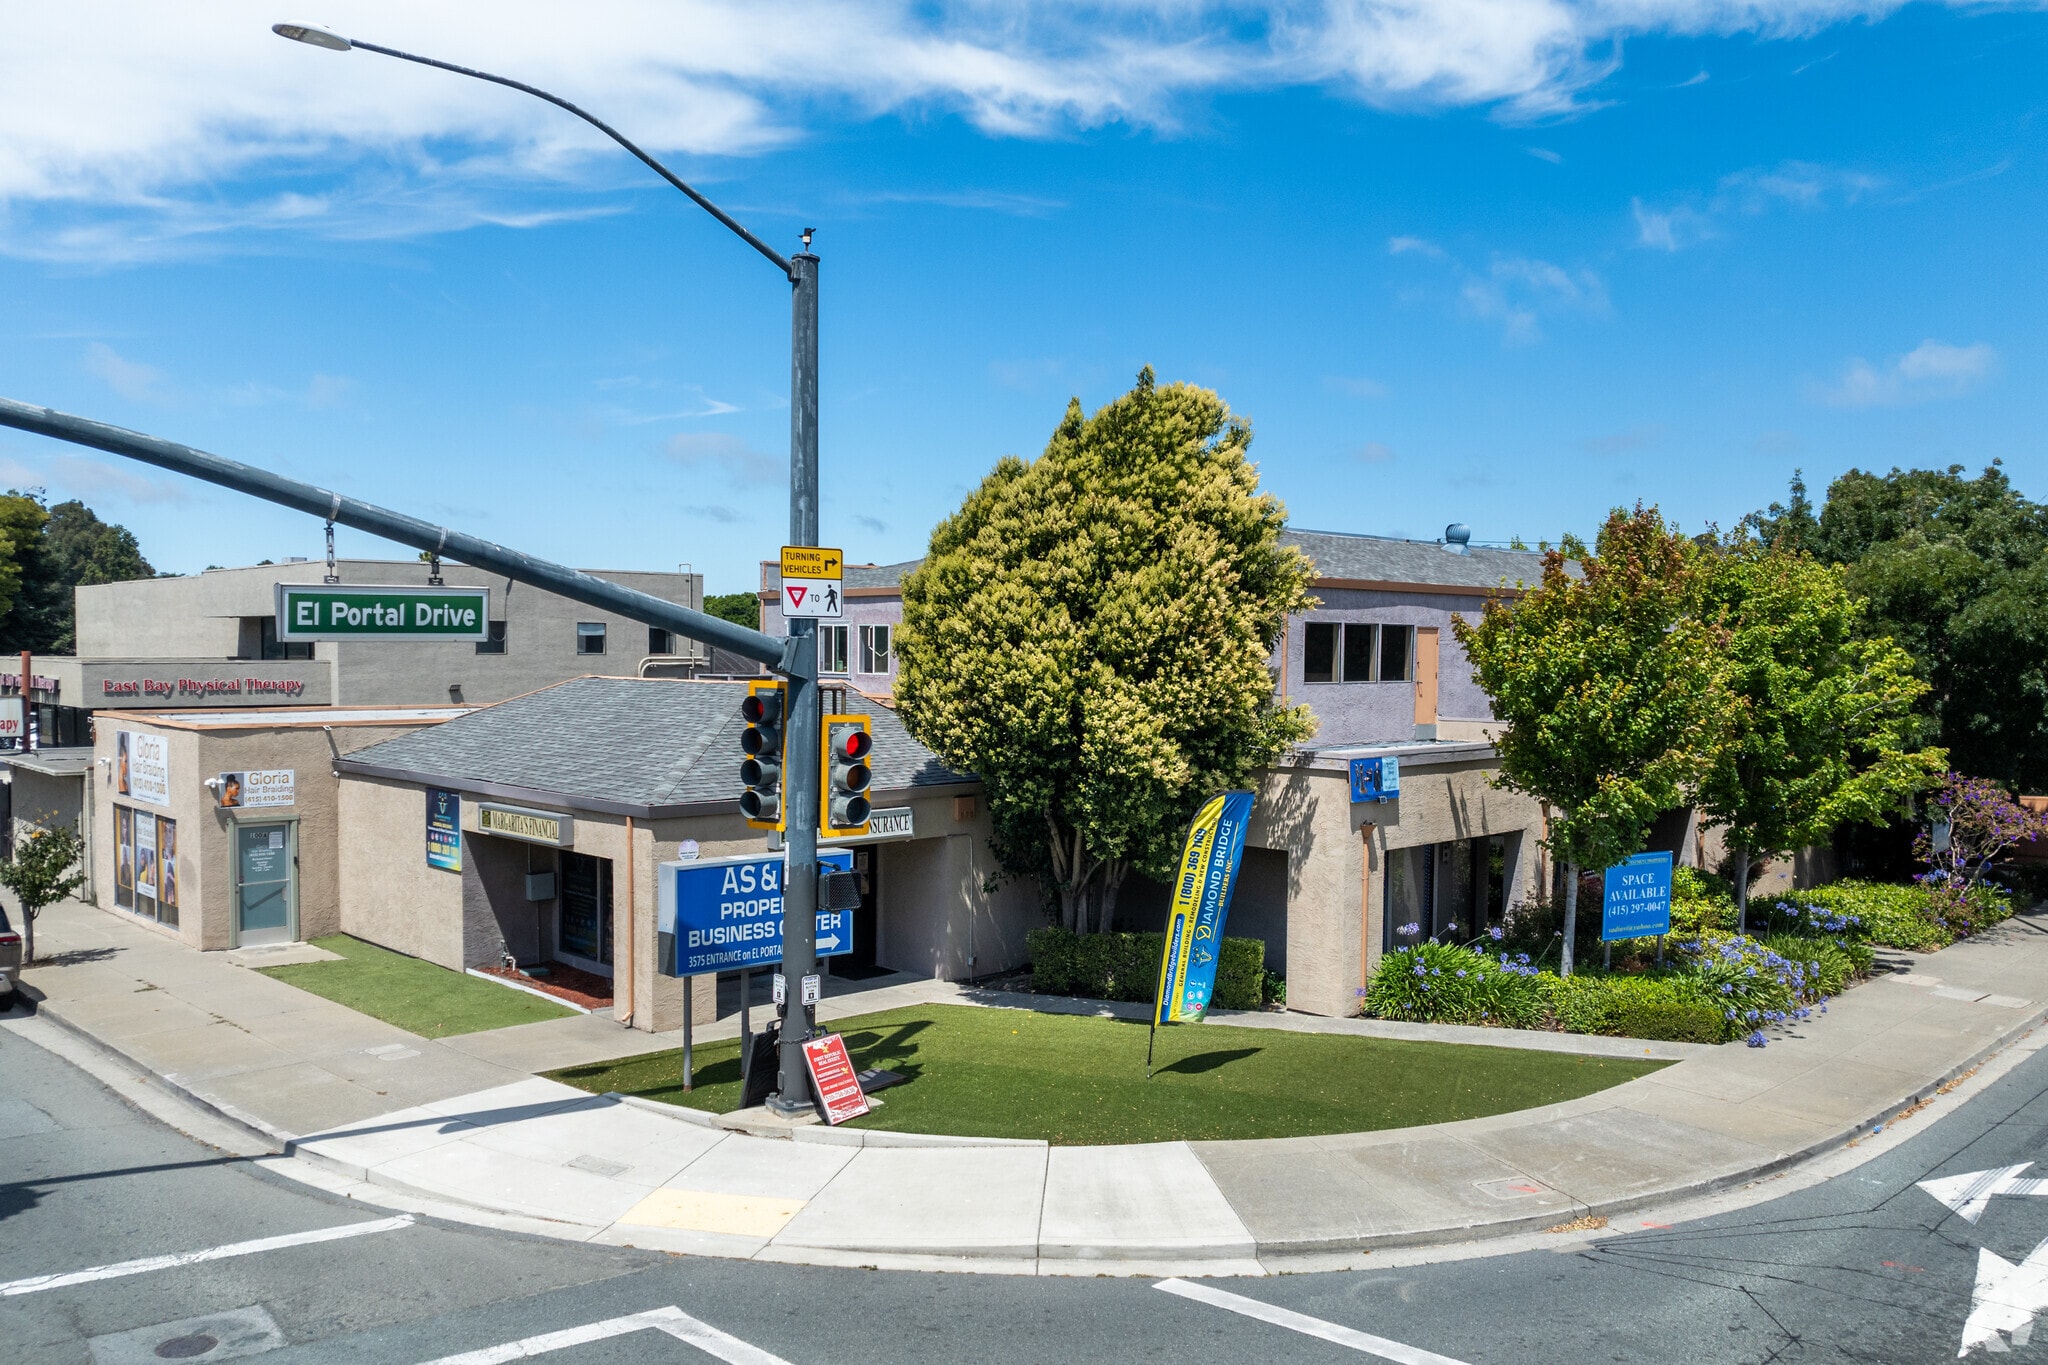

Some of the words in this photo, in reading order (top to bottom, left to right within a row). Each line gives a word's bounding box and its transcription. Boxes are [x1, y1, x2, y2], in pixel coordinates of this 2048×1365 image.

[785, 552, 820, 561] TURNING
[784, 565, 821, 574] VEHICLES
[810, 594, 820, 602] TO
[296, 601, 319, 625] El
[332, 602, 405, 626] Portal
[415, 603, 475, 626] Drive
[103, 679, 138, 692] East
[143, 679, 172, 694] Bay
[178, 678, 240, 694] Physical
[245, 678, 303, 693] Therapy
[137, 735, 160, 761] Gloria
[244, 786, 260, 794] Hair
[263, 784, 294, 793] Braiding
[249, 772, 289, 785] Gloria
[492, 811, 528, 835] MARGARITA'S
[529, 818, 560, 840] FINANCIAL
[1214, 819, 1233, 867] BRIDGE
[1187, 850, 1200, 871] 369
[1180, 872, 1196, 898] (800)
[1622, 873, 1655, 886] SPACE
[1609, 886, 1666, 902] AVAILABLE
[721, 897, 784, 920] PROPE
[1608, 905, 1629, 918] (415)
[1631, 901, 1666, 914] 297-0047
[1183, 929, 1192, 958] BUILDING
[1188, 884, 1202, 924] REMODELING
[688, 921, 775, 948] BUSINESS
[688, 955, 705, 968] 3575
[706, 949, 742, 965] ENTRANCE
[742, 952, 751, 960] on
[752, 948, 760, 959] EL
[760, 945, 784, 957] PORTA
